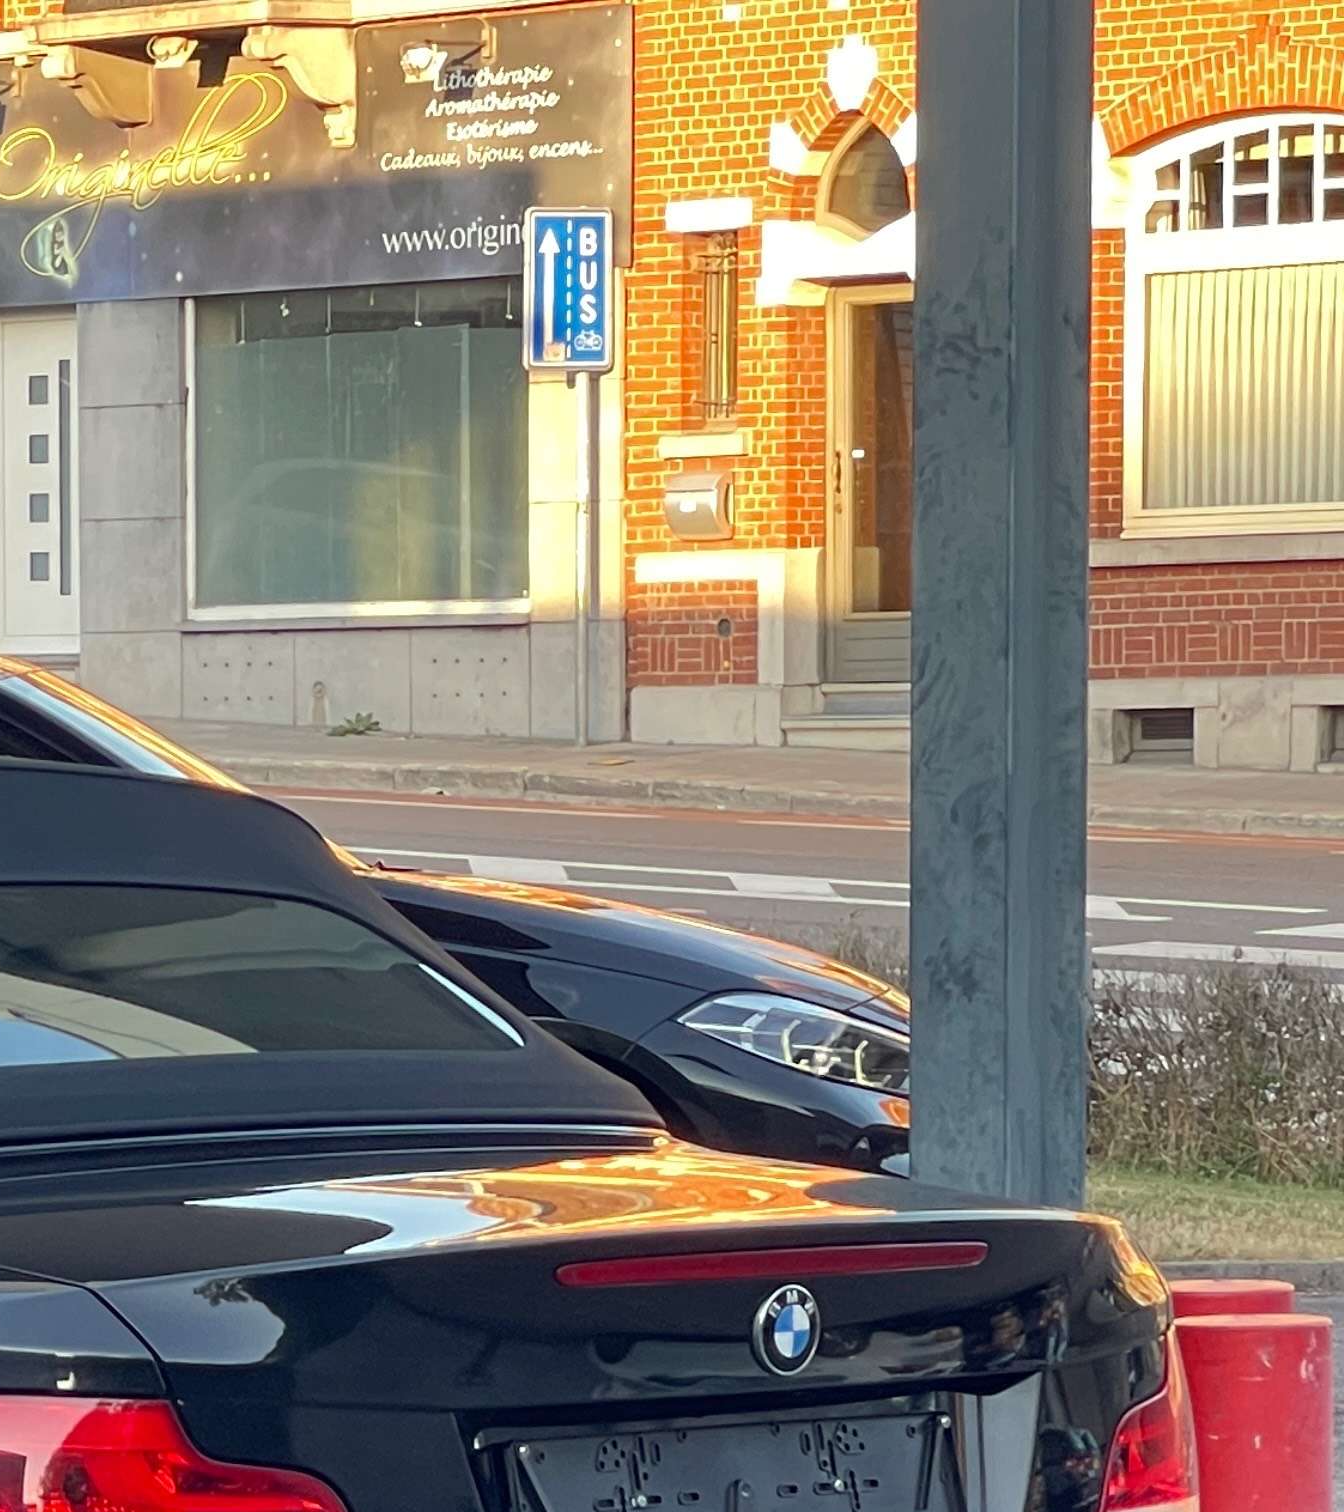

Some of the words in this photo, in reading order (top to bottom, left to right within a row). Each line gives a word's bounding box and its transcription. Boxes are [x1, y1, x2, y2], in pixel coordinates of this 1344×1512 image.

[425, 90, 560, 117] Aromathérapie
[446, 118, 539, 141] Esotérisme
[382, 216, 526, 256] www.origin
[578, 227, 598, 324] BUS
